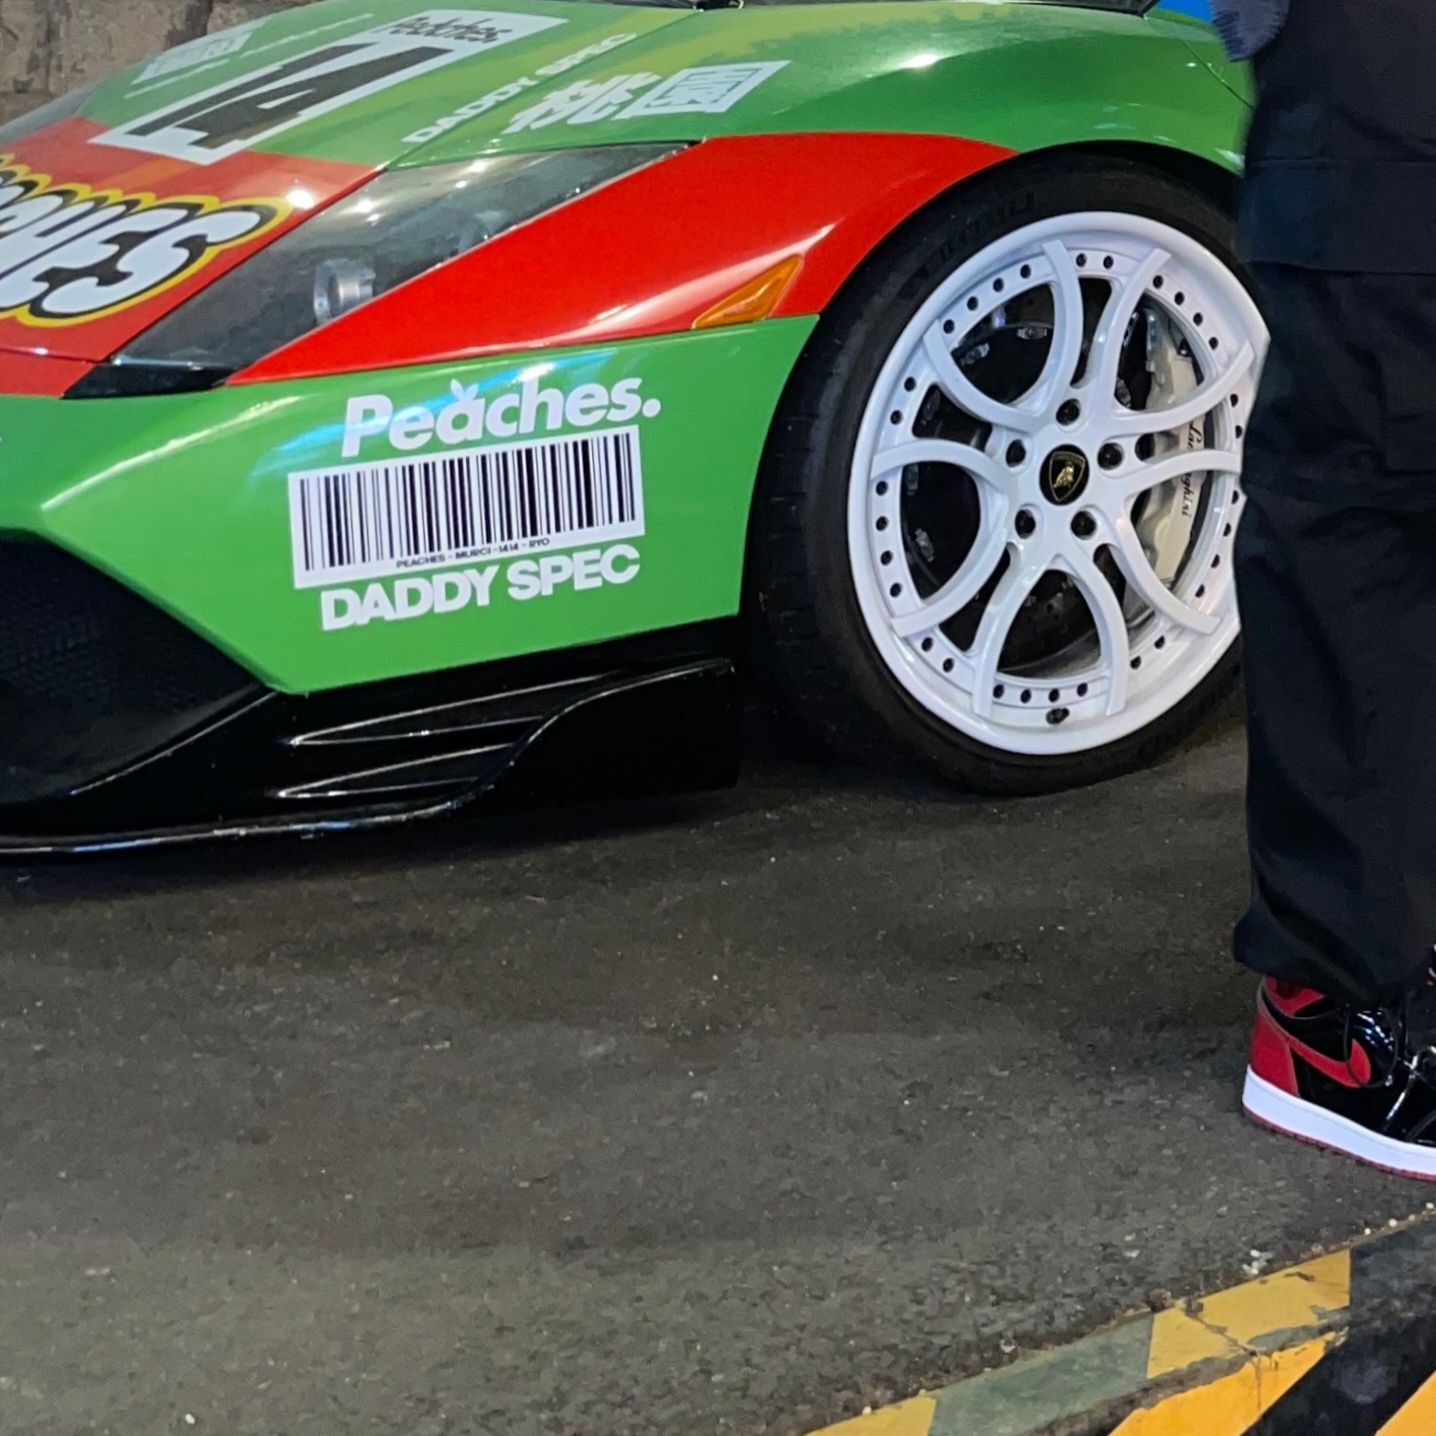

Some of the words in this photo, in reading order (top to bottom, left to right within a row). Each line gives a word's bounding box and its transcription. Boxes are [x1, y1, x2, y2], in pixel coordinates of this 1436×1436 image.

[401, 75, 540, 143] DADDY
[535, 32, 638, 77] SPEC
[341, 376, 662, 458] Peaches.
[320, 565, 500, 631] DADDY
[507, 544, 641, 601] SPEC
[396, 553, 446, 569] PEACHES
